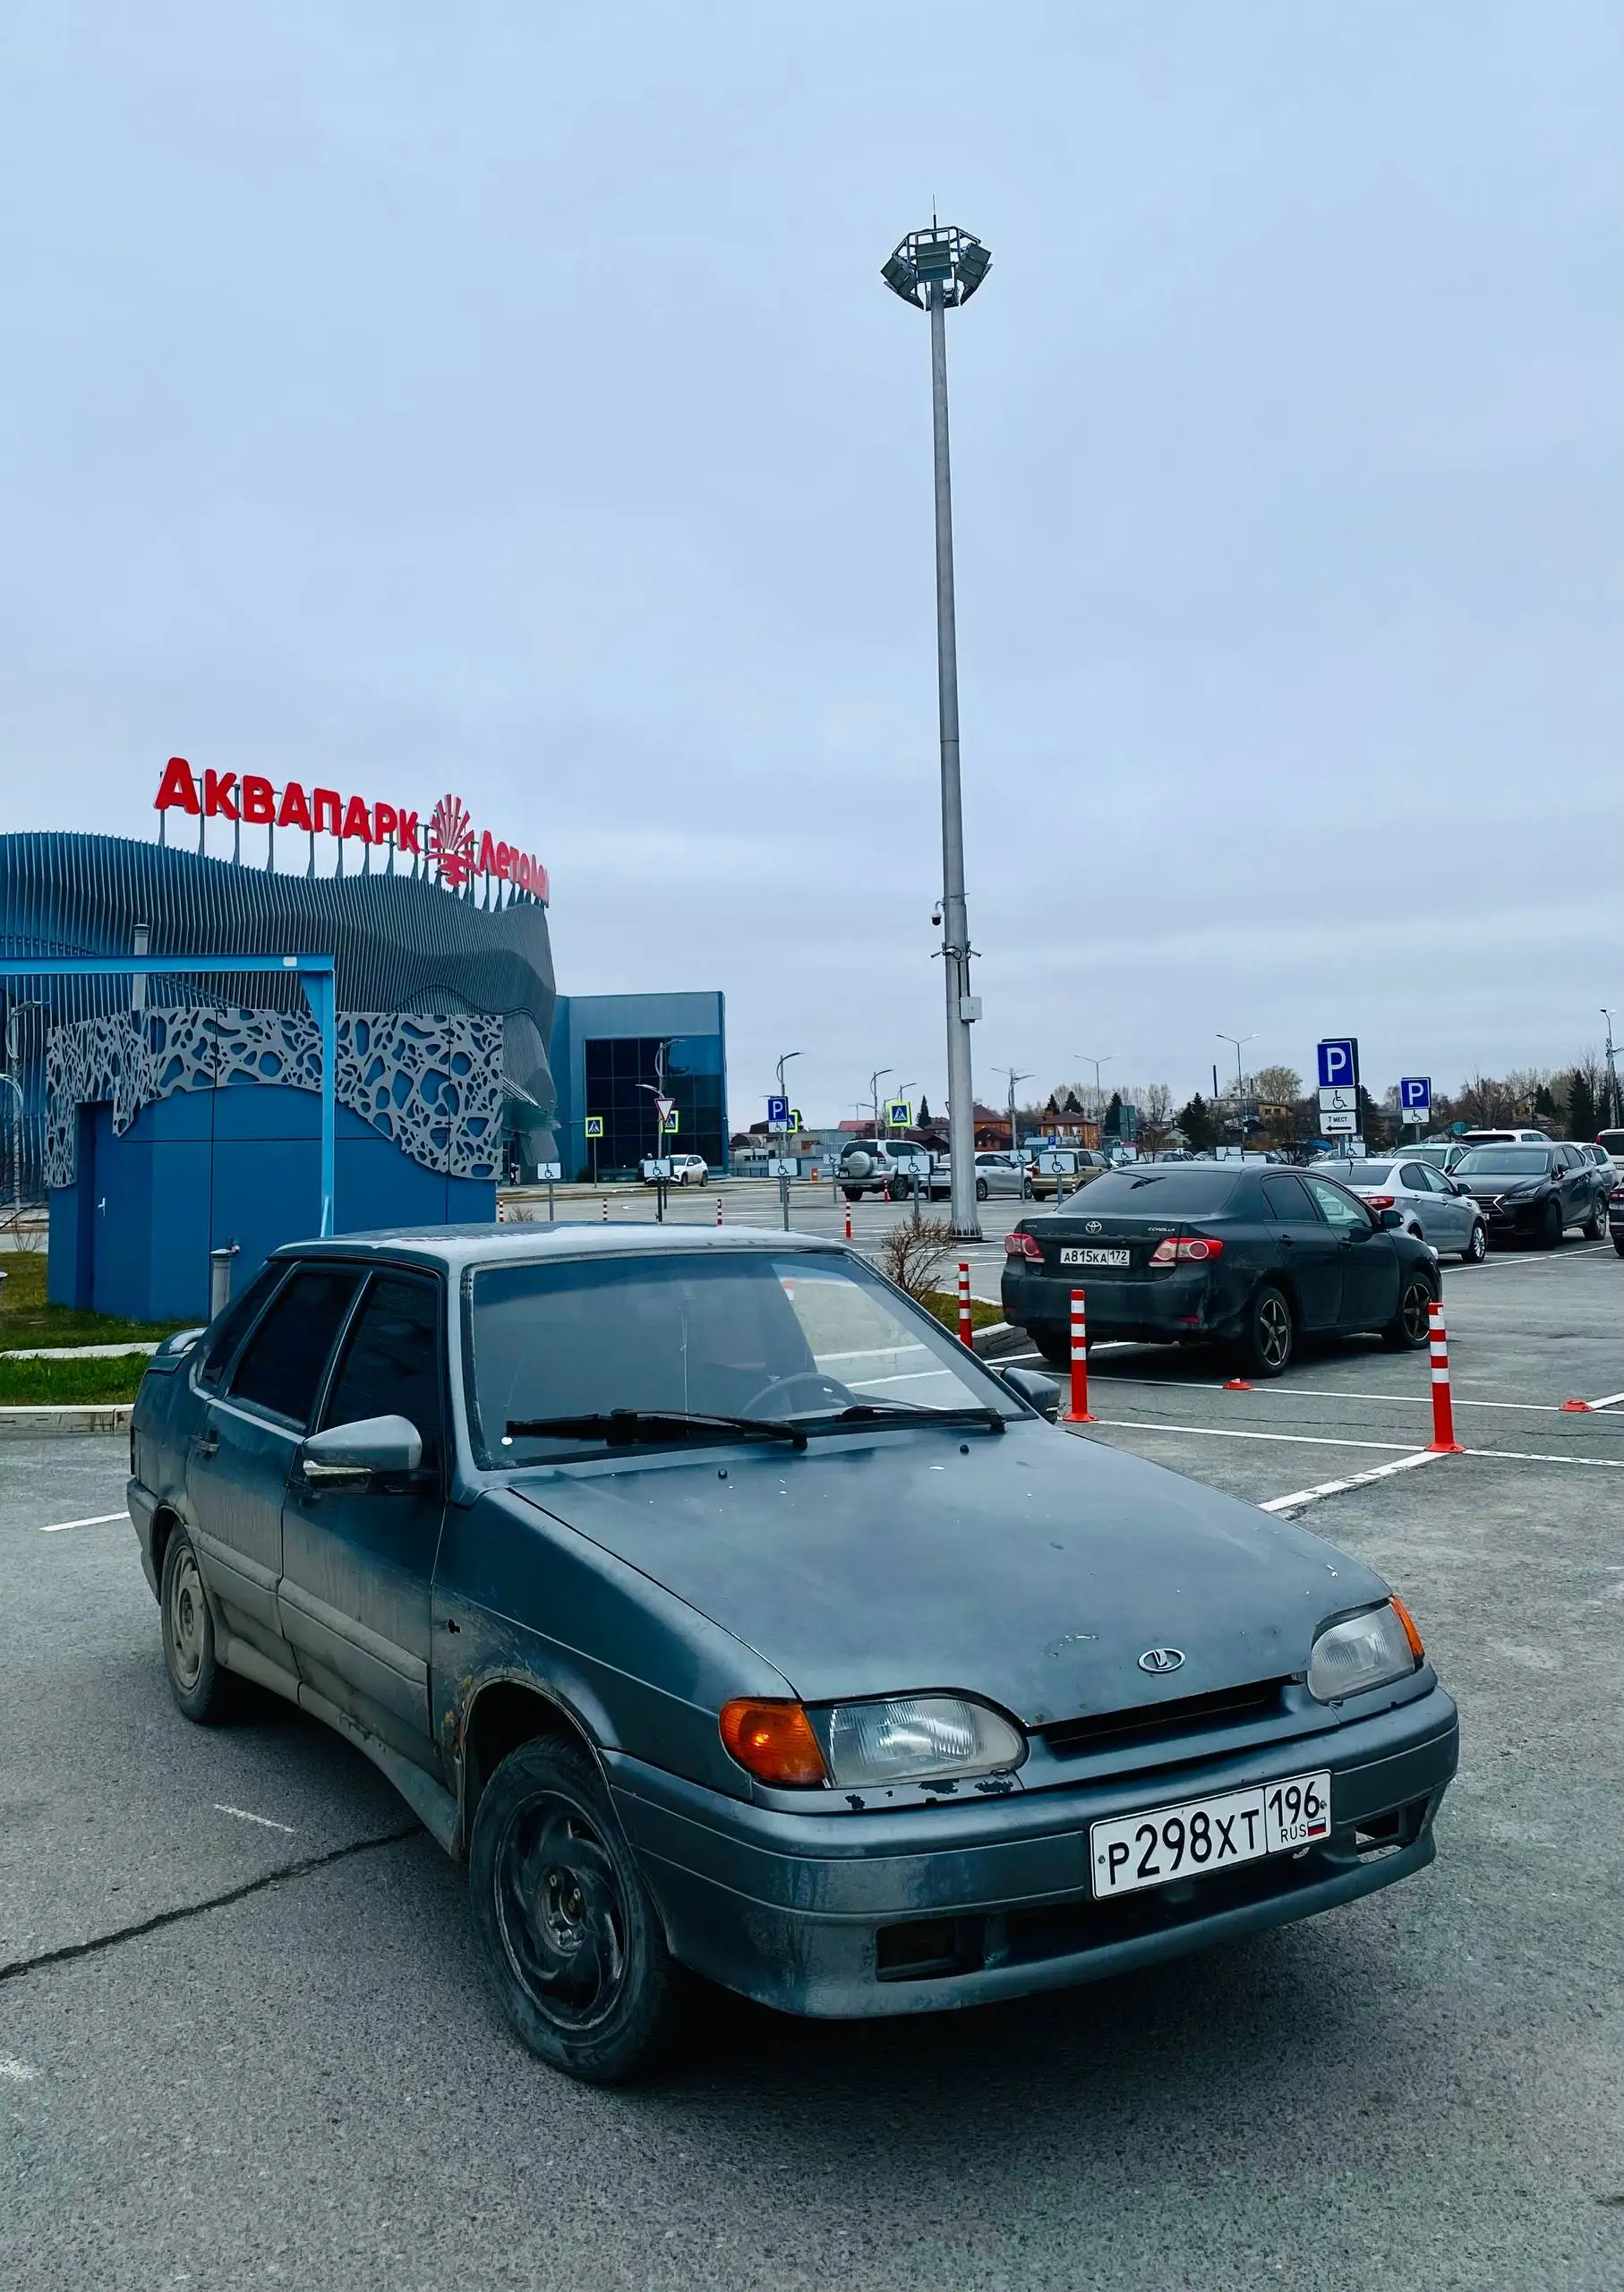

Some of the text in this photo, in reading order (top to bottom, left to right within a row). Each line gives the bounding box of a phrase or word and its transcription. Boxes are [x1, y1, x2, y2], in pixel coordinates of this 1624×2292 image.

[154, 757, 421, 855] АКВАПАРК
[1327, 1048, 1346, 1082] P
[1408, 1082, 1424, 1106] P
[773, 1100, 783, 1119] P
[1109, 1250, 1127, 1261] 172
[1107, 1780, 1321, 1886] Р298ХТ 196
[1280, 1824, 1307, 1843] RUS
